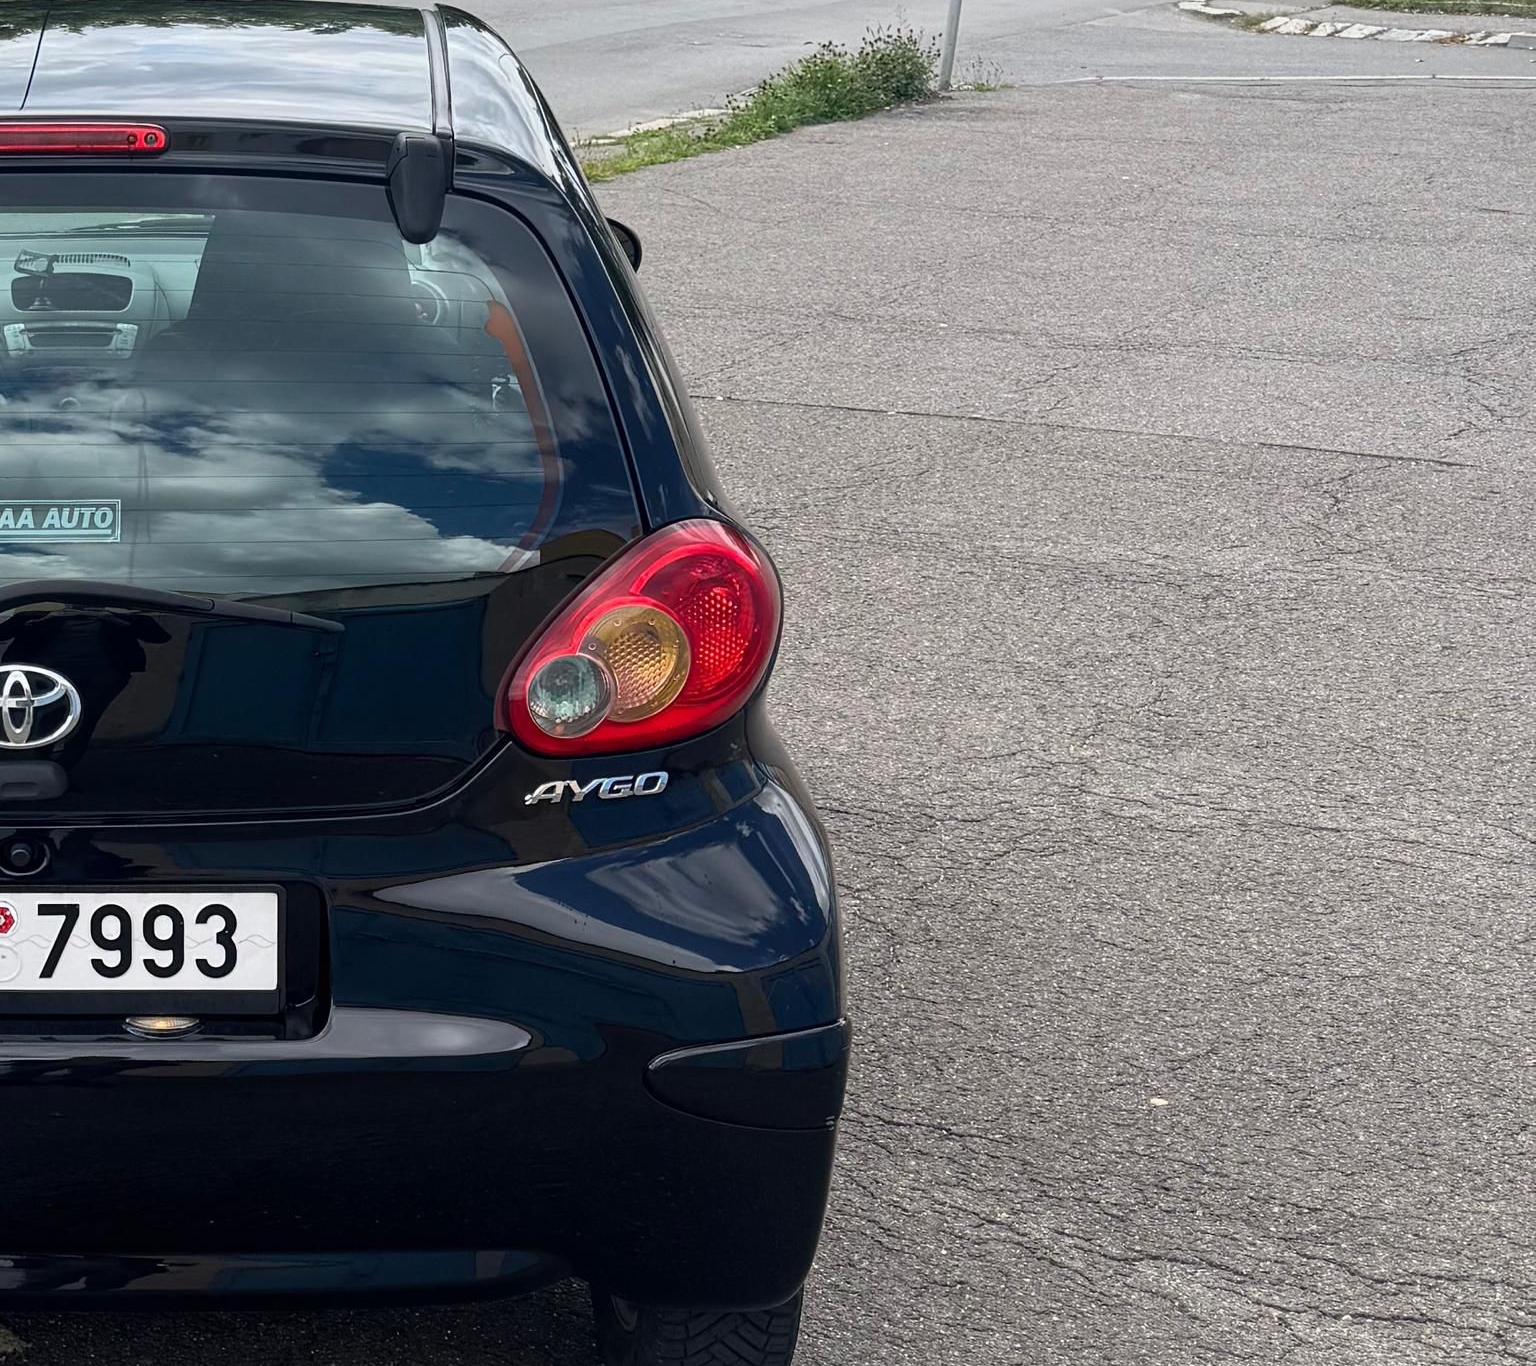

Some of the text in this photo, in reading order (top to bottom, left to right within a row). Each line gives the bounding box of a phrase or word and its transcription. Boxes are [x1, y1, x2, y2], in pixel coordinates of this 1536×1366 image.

[42, 507, 114, 529] AUTO
[524, 771, 669, 805] AYGO
[37, 903, 238, 979] 7993
